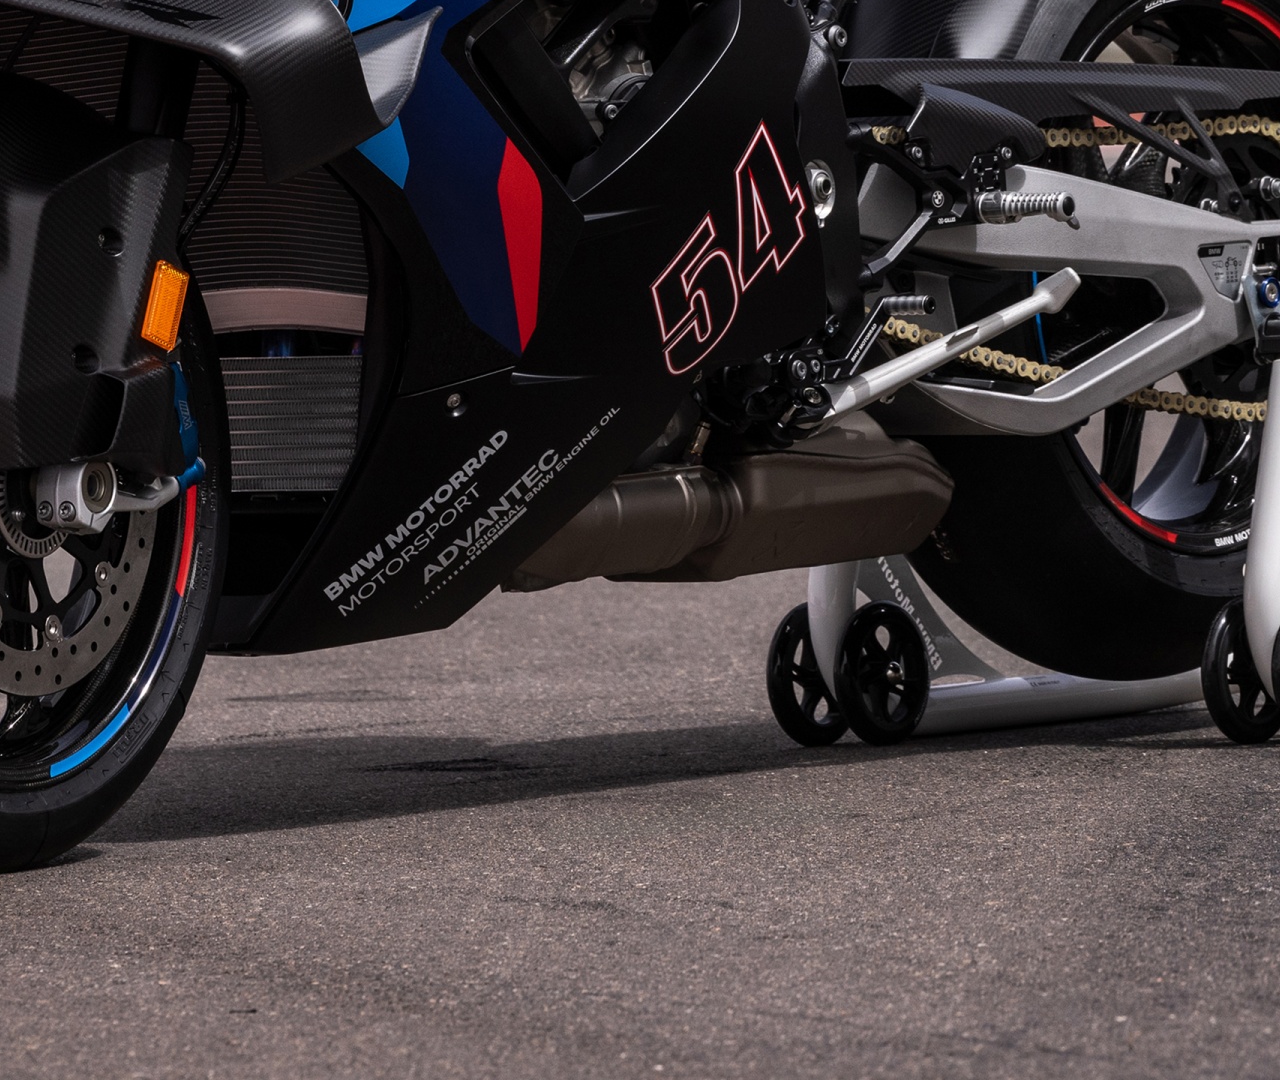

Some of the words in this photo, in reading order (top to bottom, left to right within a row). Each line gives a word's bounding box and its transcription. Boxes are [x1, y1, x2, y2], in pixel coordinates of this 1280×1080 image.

[650, 118, 806, 375] 54
[323, 539, 385, 602] BMW
[385, 429, 510, 552] MOTORRAD
[337, 482, 481, 618] MOTORSPORT
[423, 448, 562, 586] ADVANTEC
[466, 504, 525, 556] ORIGINAL
[524, 470, 556, 503] BMW
[555, 426, 600, 472] ENGINE
[599, 406, 622, 427] OIL
[1214, 535, 1234, 547] BMW
[1234, 528, 1250, 542] MOT
